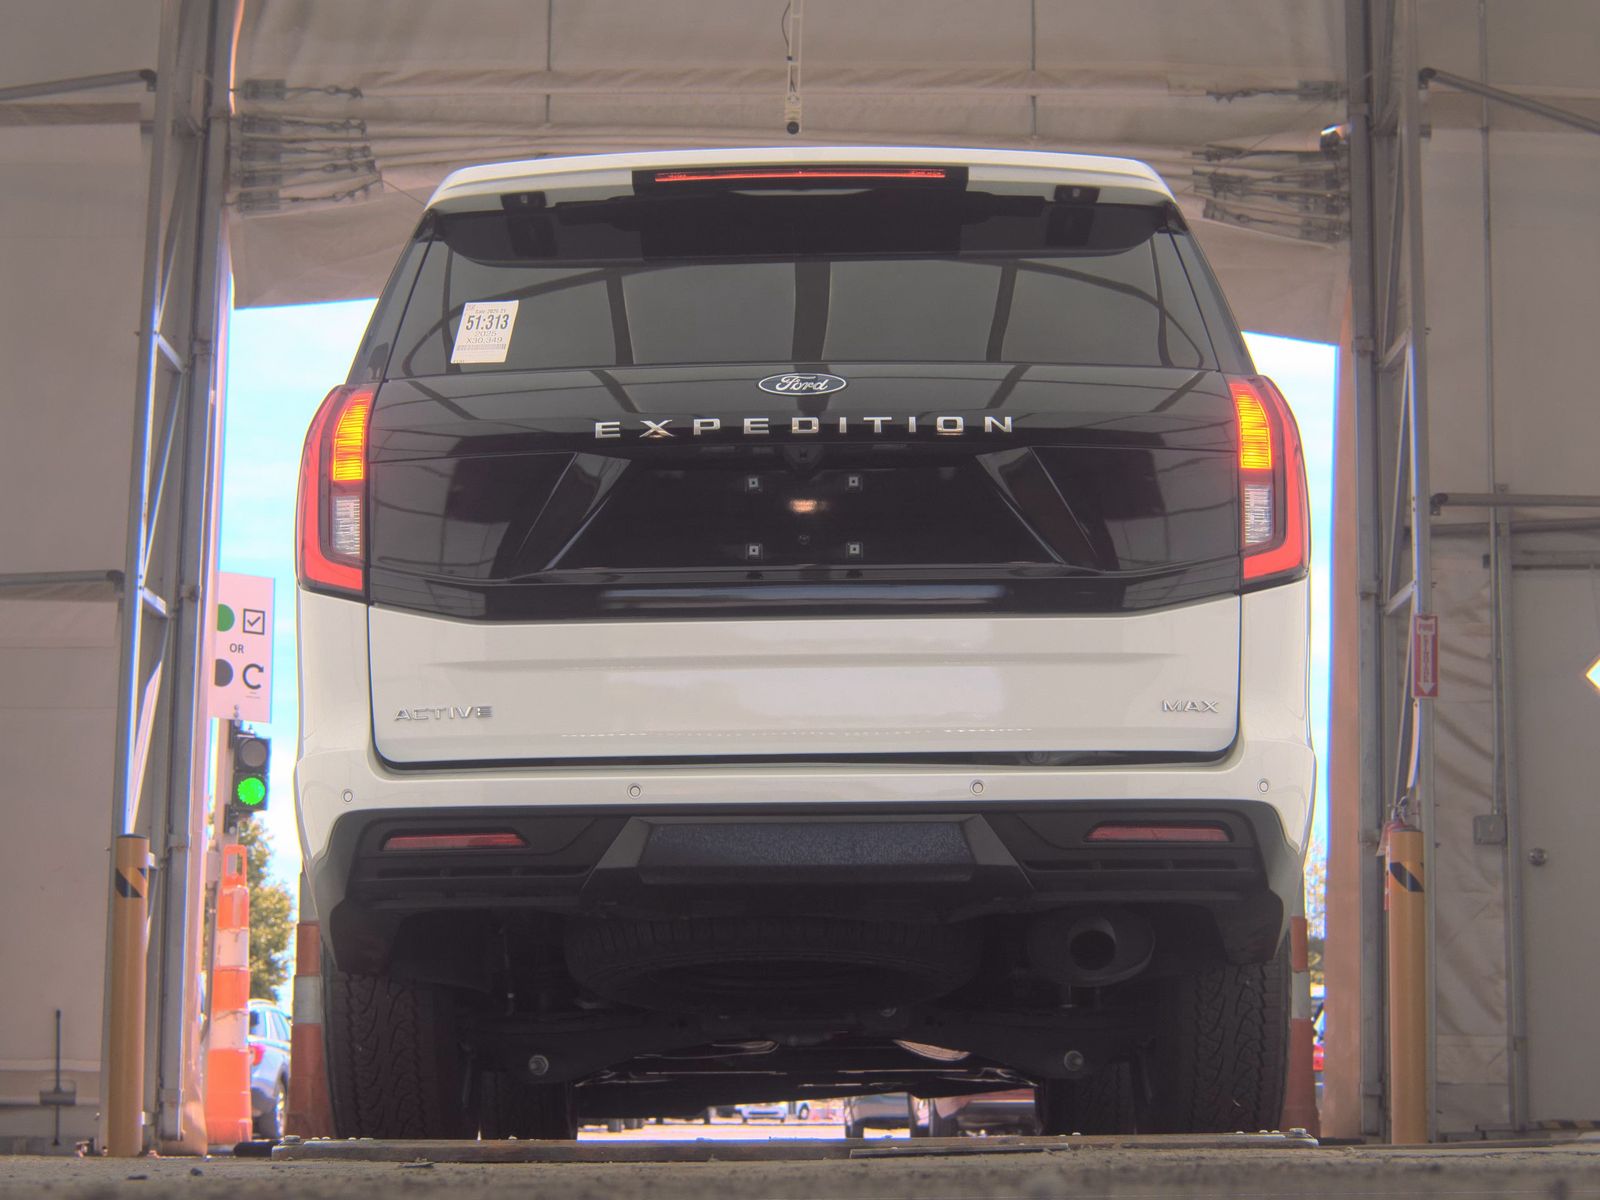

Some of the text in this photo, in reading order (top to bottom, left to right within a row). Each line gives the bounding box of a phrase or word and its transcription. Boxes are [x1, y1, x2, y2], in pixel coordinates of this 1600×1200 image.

[466, 314, 509, 330] 51:313
[776, 376, 829, 391] Ford
[595, 416, 1013, 438] EXPEDITION
[229, 643, 244, 653] OR
[395, 706, 493, 720] ACTIVE
[1162, 700, 1219, 713] MAX
